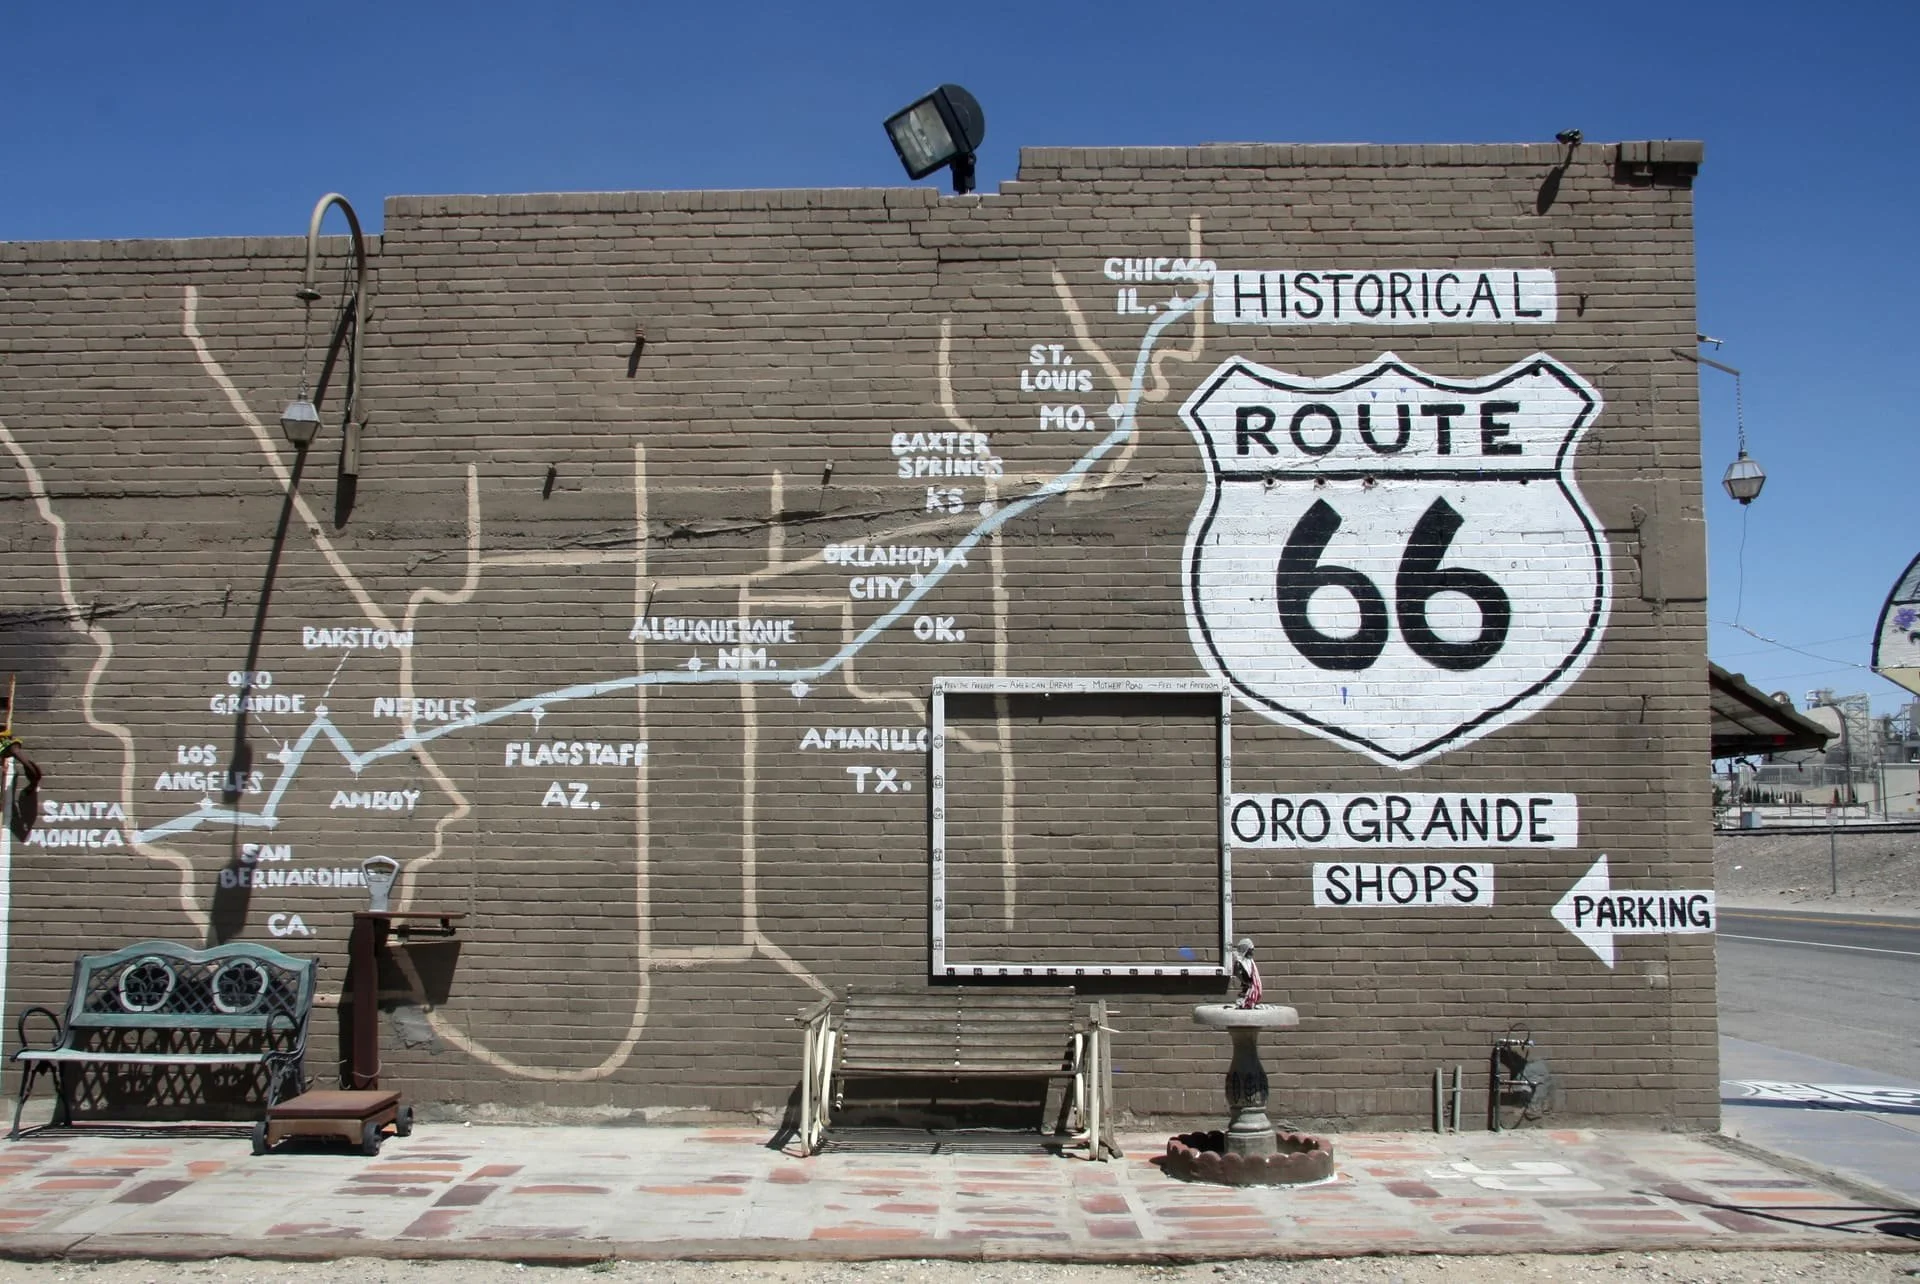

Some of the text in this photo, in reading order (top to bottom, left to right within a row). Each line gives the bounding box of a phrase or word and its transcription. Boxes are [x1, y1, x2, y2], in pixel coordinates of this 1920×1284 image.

[1103, 257, 1217, 281] CHICAGO
[1117, 288, 1157, 315] IL.
[1233, 272, 1542, 319] HISTORICAL
[1029, 344, 1073, 365] ST.
[1020, 370, 1094, 392] LOUIS
[1039, 404, 1095, 431] MO.
[1236, 401, 1523, 456] ROUTE
[891, 432, 991, 456] BAXTER
[898, 456, 1004, 479] SPRINGS
[926, 486, 965, 514] KS
[823, 544, 968, 567] OKLAHOMA
[849, 577, 904, 599] CITY
[1276, 495, 1511, 672] 66
[303, 626, 413, 649] BARSTOW
[630, 617, 796, 644] ALBUQUERQUE
[913, 615, 966, 642] OK.
[718, 647, 777, 669] NM.
[227, 671, 273, 690] ORO
[210, 693, 305, 715] GRANDE
[374, 697, 478, 721] NEEDLES
[178, 745, 217, 766] LOS
[505, 742, 648, 767] FLAGSTAFF
[154, 772, 265, 794] ANGELES
[846, 766, 912, 793] TX.
[330, 790, 420, 811] AMBOY
[541, 781, 600, 810] AZ.
[42, 799, 128, 823] SANTA
[1343, 796, 1555, 843] GRANDE
[24, 828, 124, 848] MONICA
[241, 843, 291, 864] SAN
[1325, 864, 1479, 905] SHOPS
[1573, 895, 1711, 928] PARKING
[267, 913, 318, 936] CA.
